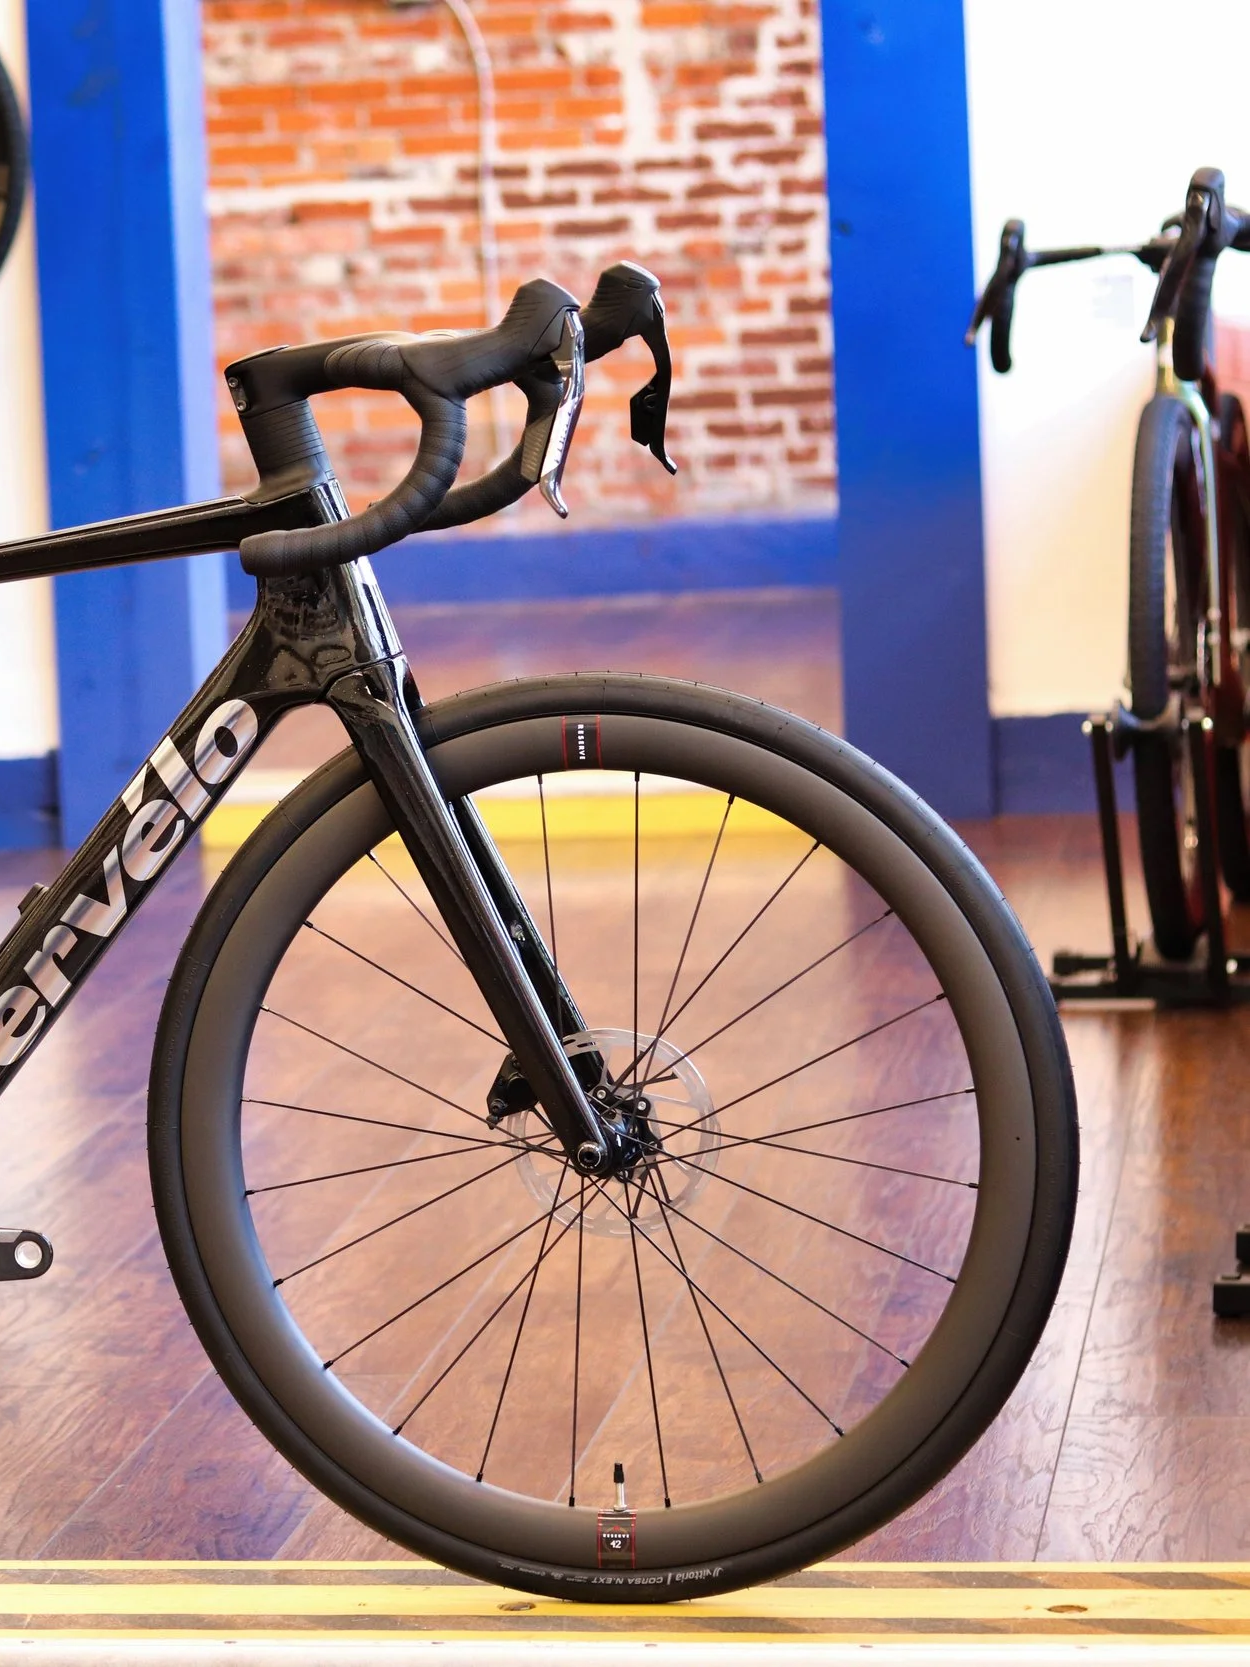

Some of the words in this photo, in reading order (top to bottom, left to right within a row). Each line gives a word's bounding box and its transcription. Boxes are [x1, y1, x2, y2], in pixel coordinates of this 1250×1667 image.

[577, 723, 586, 760] RESERVE
[610, 1539, 622, 1549] 42
[591, 1576, 624, 1584] N.EXT
[675, 1567, 712, 1583] vittoria
[627, 1576, 663, 1585] CORSA
